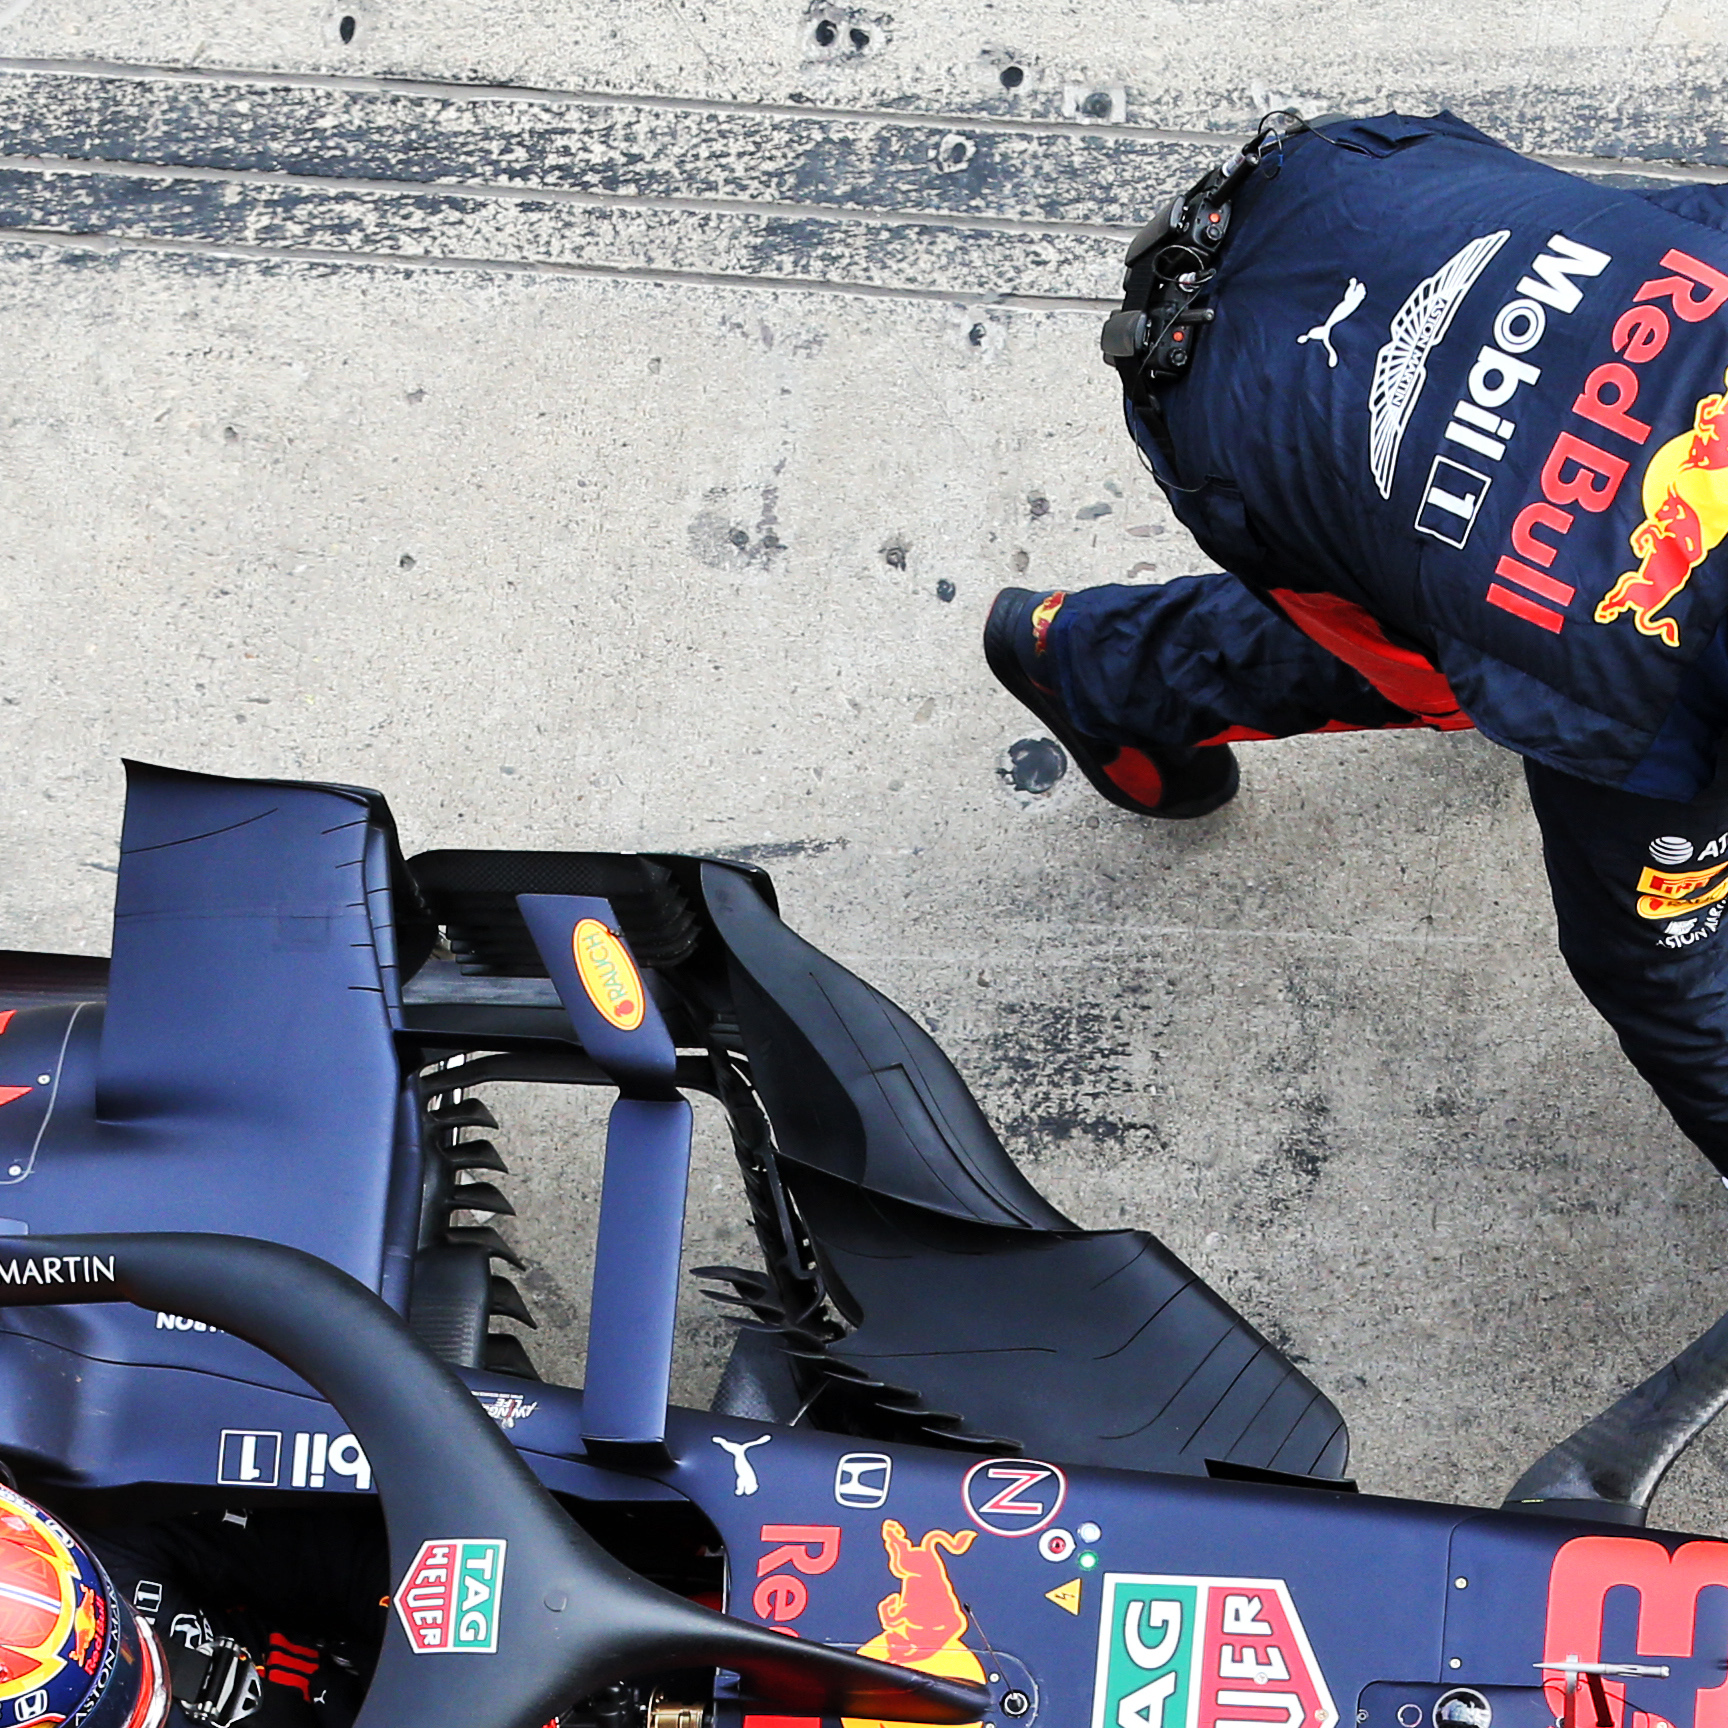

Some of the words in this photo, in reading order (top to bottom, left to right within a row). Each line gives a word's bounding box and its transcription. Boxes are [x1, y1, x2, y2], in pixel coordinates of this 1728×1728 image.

[1415, 296, 1449, 349] ASTON
[1440, 233, 1613, 463] Mobil
[1391, 350, 1424, 408] MARTIN
[1486, 432, 1633, 636] Bull
[582, 932, 631, 1001] RAUCH
[406, 1546, 451, 1648] HEUER
[459, 1548, 496, 1643] TAG
